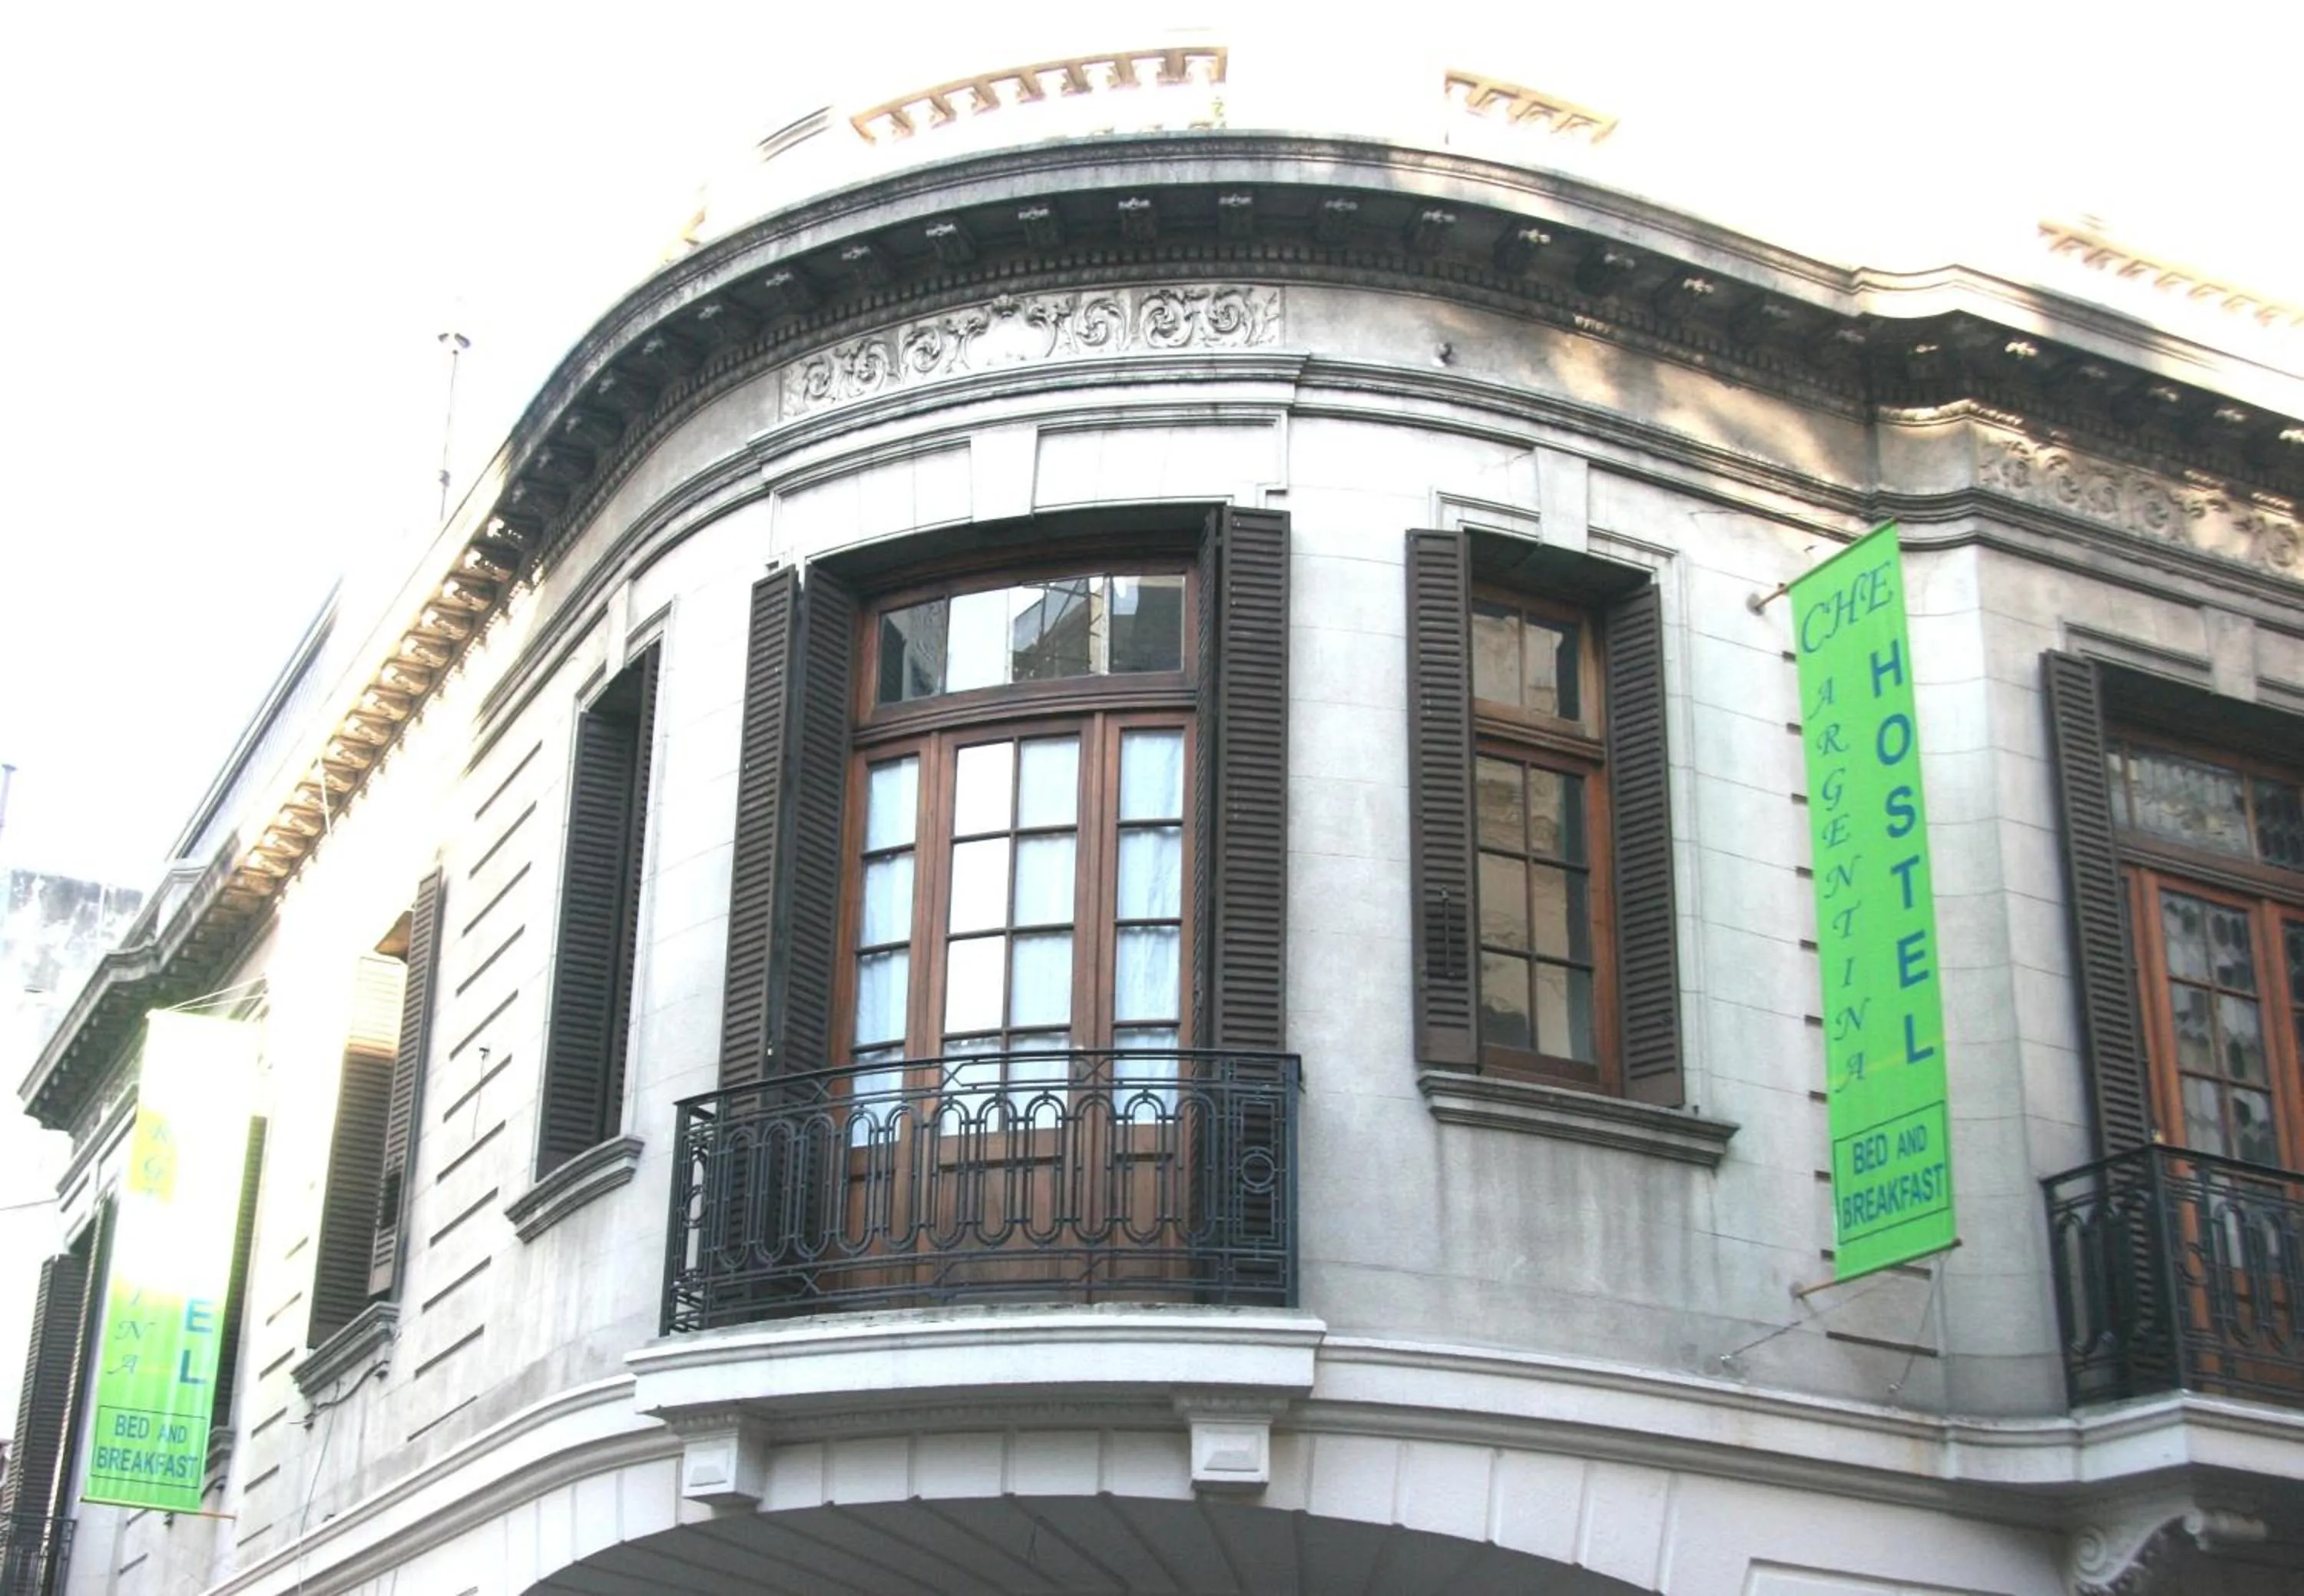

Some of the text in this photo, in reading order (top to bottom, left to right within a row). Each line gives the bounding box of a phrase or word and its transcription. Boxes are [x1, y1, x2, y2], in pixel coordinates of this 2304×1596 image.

[1801, 561, 1894, 654] CHE
[1807, 676, 1871, 1094] ARGENTINA
[1869, 638, 1934, 1065] HOSTEL
[1852, 1124, 1928, 1176] BED AND
[1842, 1163, 1945, 1230] BREAKFAST
[95, 1446, 199, 1478] BREAKFAST
[114, 1414, 187, 1444] BED AND
